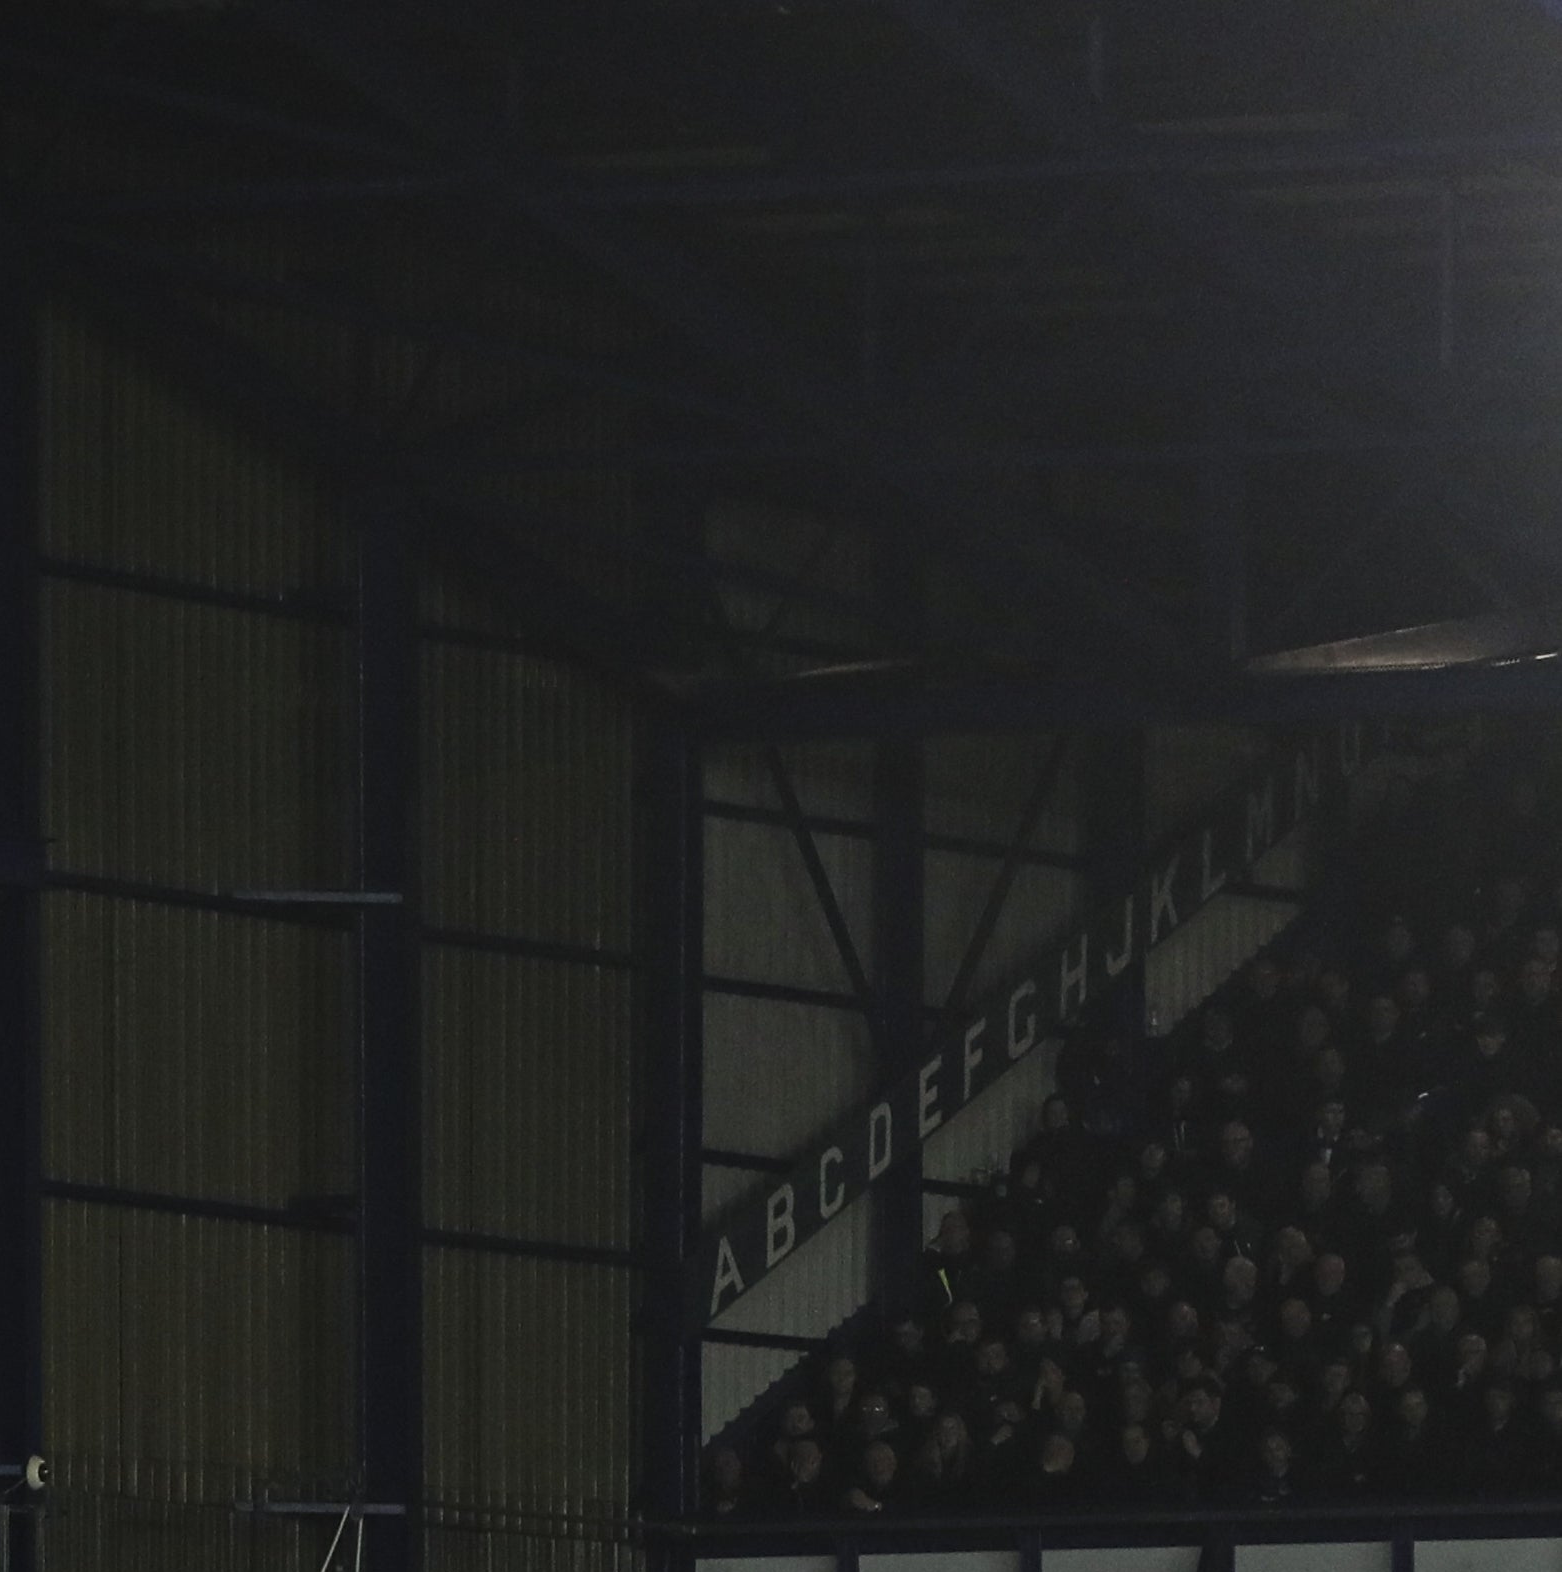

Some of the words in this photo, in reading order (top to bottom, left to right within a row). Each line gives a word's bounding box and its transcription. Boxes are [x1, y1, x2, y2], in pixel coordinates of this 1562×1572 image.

[710, 1236, 745, 1317] A
[766, 1183, 795, 1268] B
[820, 1146, 845, 1220] C
[869, 1102, 892, 1181] D
[918, 1054, 942, 1140] E
[963, 1017, 985, 1101] F
[1008, 979, 1035, 1061] G
[1061, 933, 1087, 1020] H
[1107, 894, 1133, 977] J
[1151, 855, 1180, 943] K
[1203, 827, 1226, 901] L
